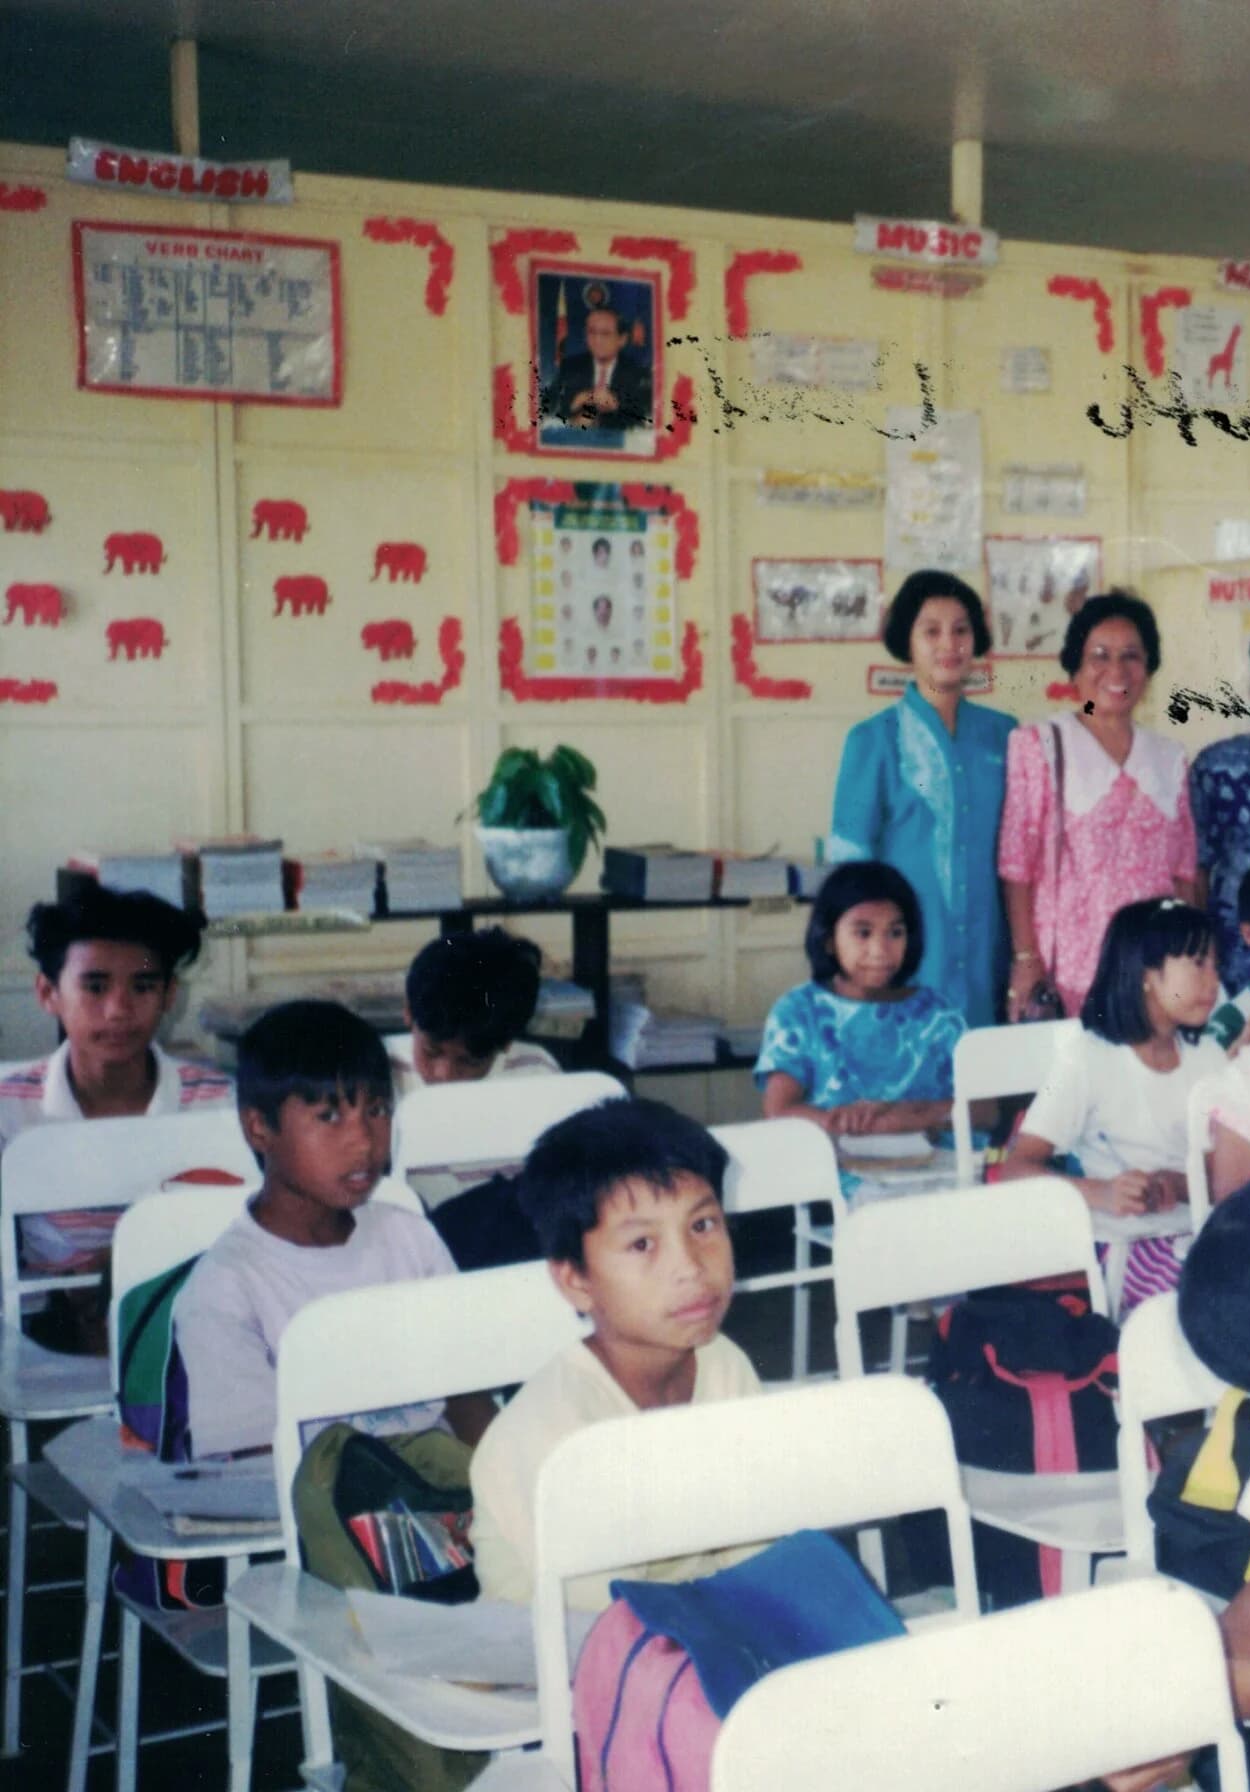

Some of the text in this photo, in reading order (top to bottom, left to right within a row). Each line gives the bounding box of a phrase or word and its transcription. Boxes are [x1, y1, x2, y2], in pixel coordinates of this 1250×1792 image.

[95, 150, 269, 198] ENGLISH
[145, 240, 264, 263] VERB CHART
[876, 223, 982, 258] MUSIC
